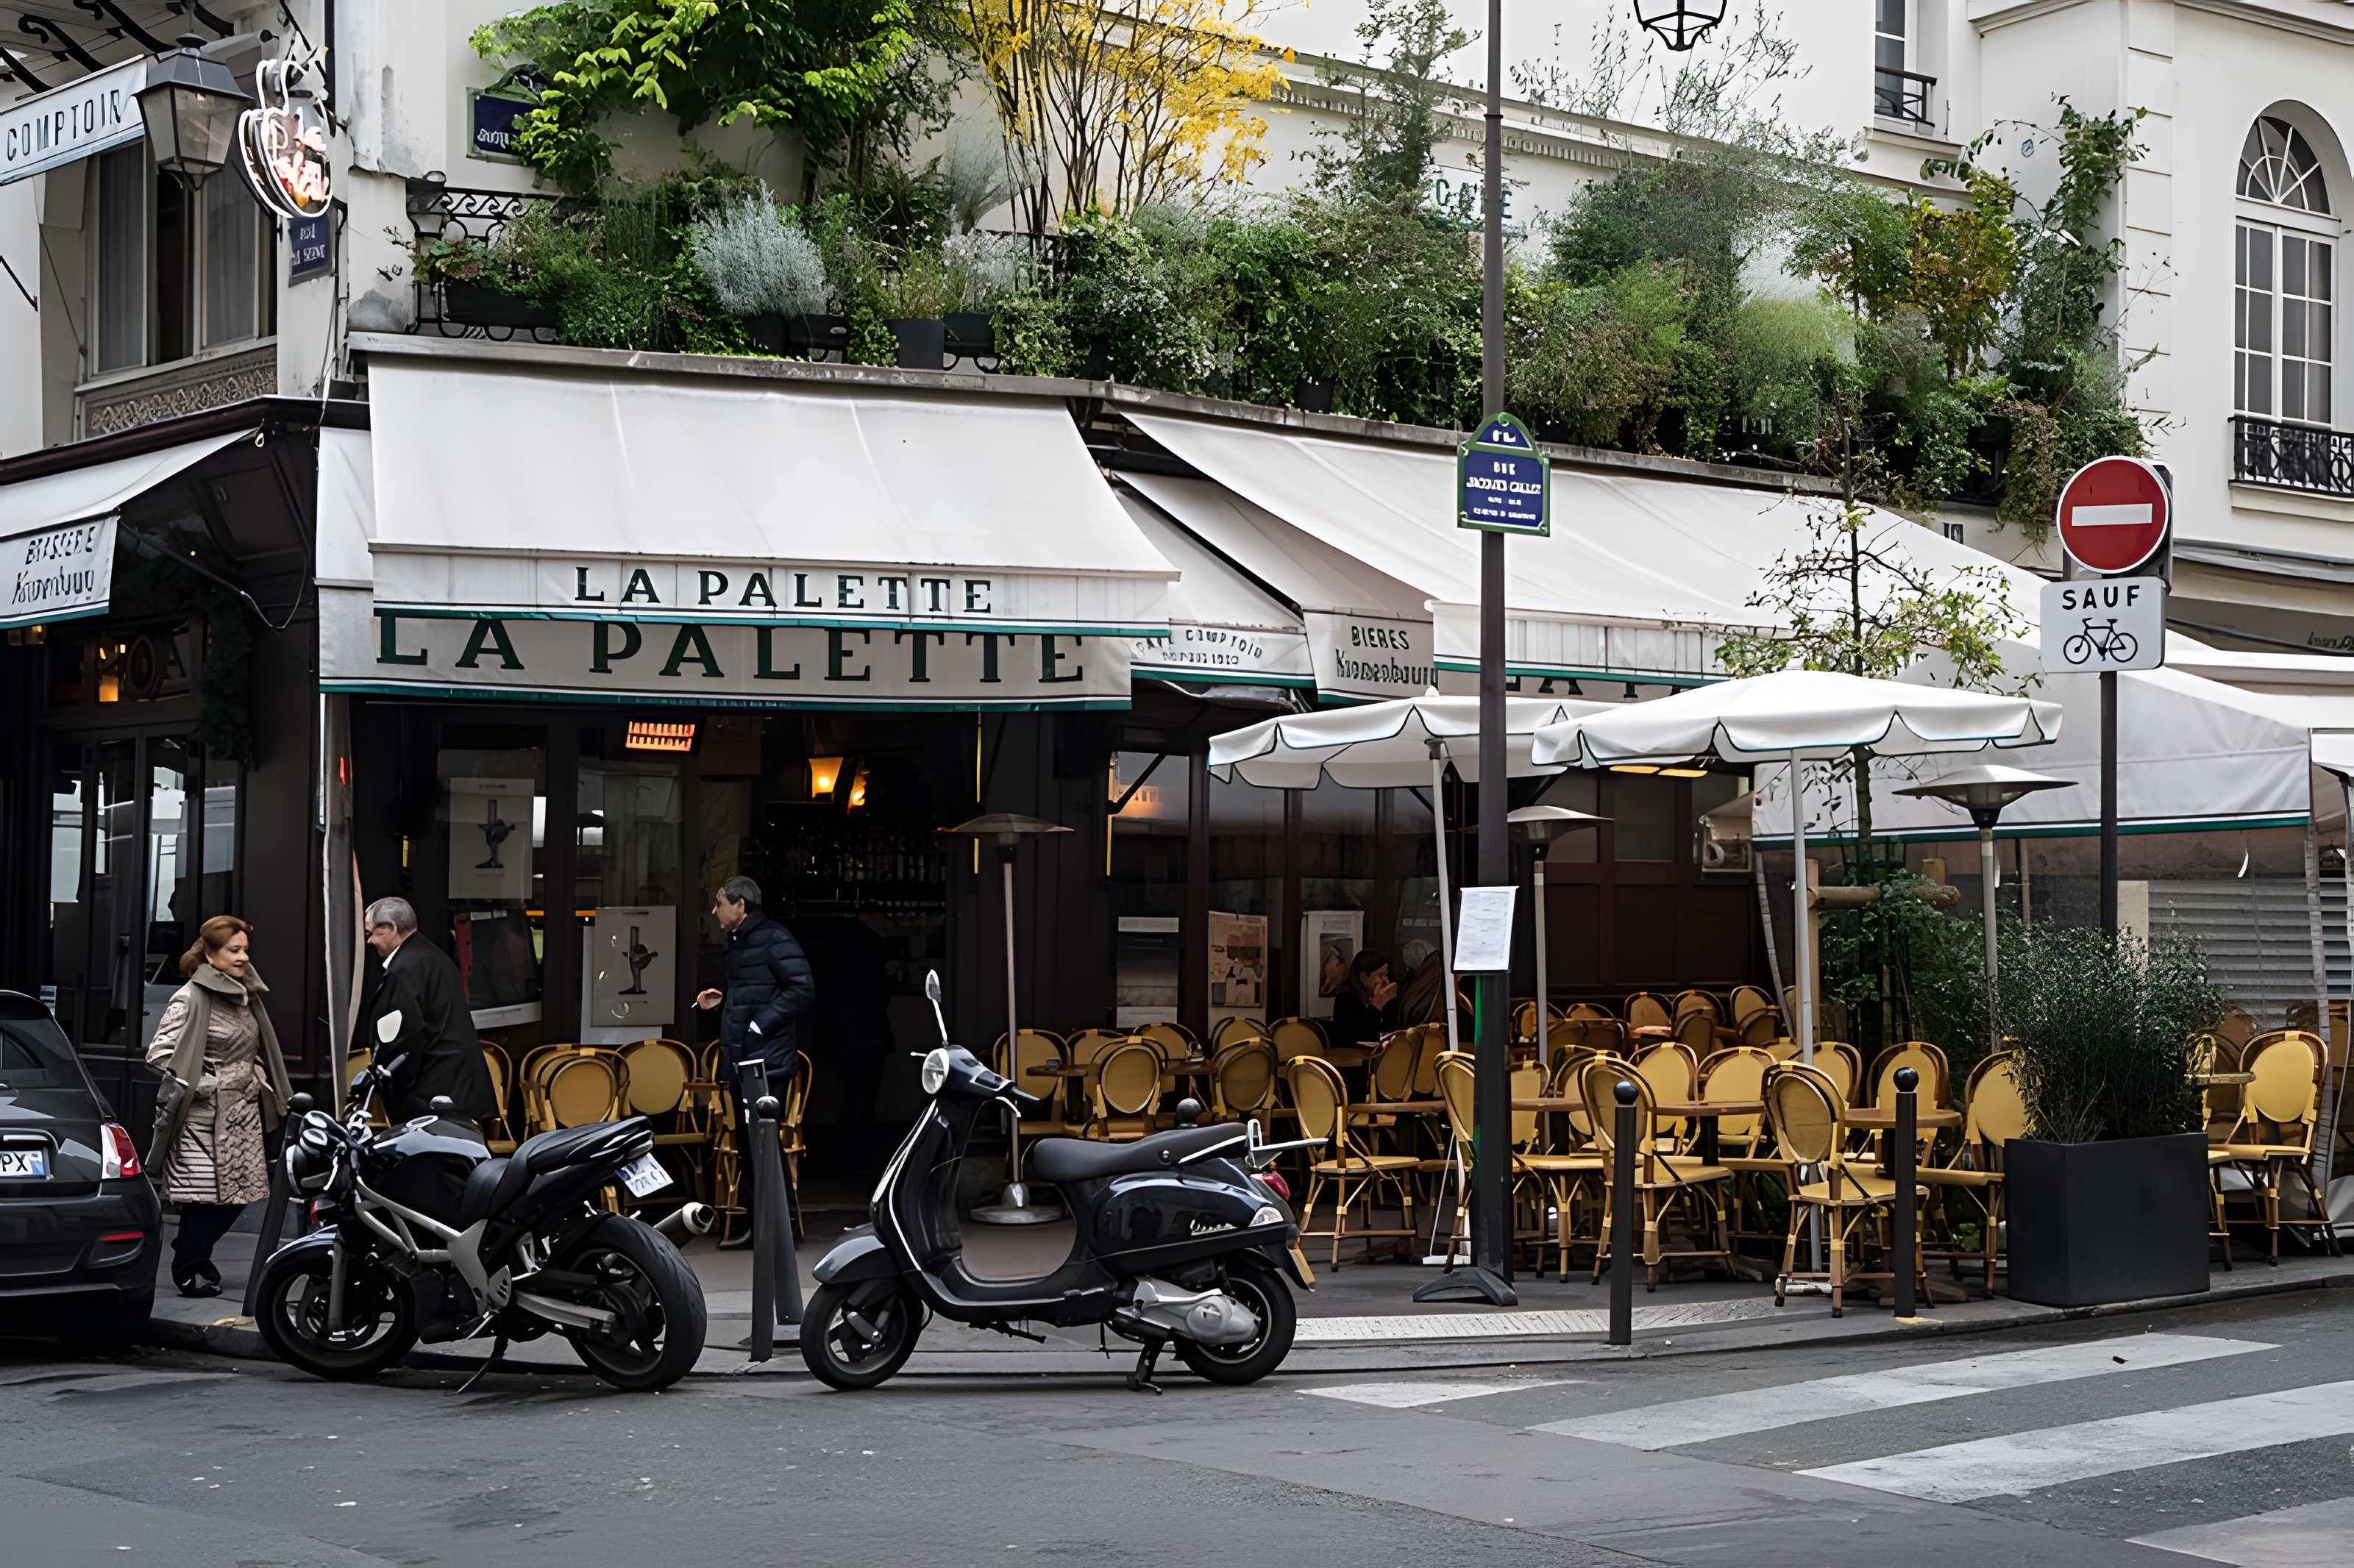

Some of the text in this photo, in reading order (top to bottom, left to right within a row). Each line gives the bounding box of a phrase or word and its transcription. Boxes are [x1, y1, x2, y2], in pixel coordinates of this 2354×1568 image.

[7, 89, 121, 161] COMPTOIR
[575, 566, 991, 613] LA PALETTE
[2062, 585, 2140, 610] SAUF
[376, 615, 1083, 684] LA PALETTE
